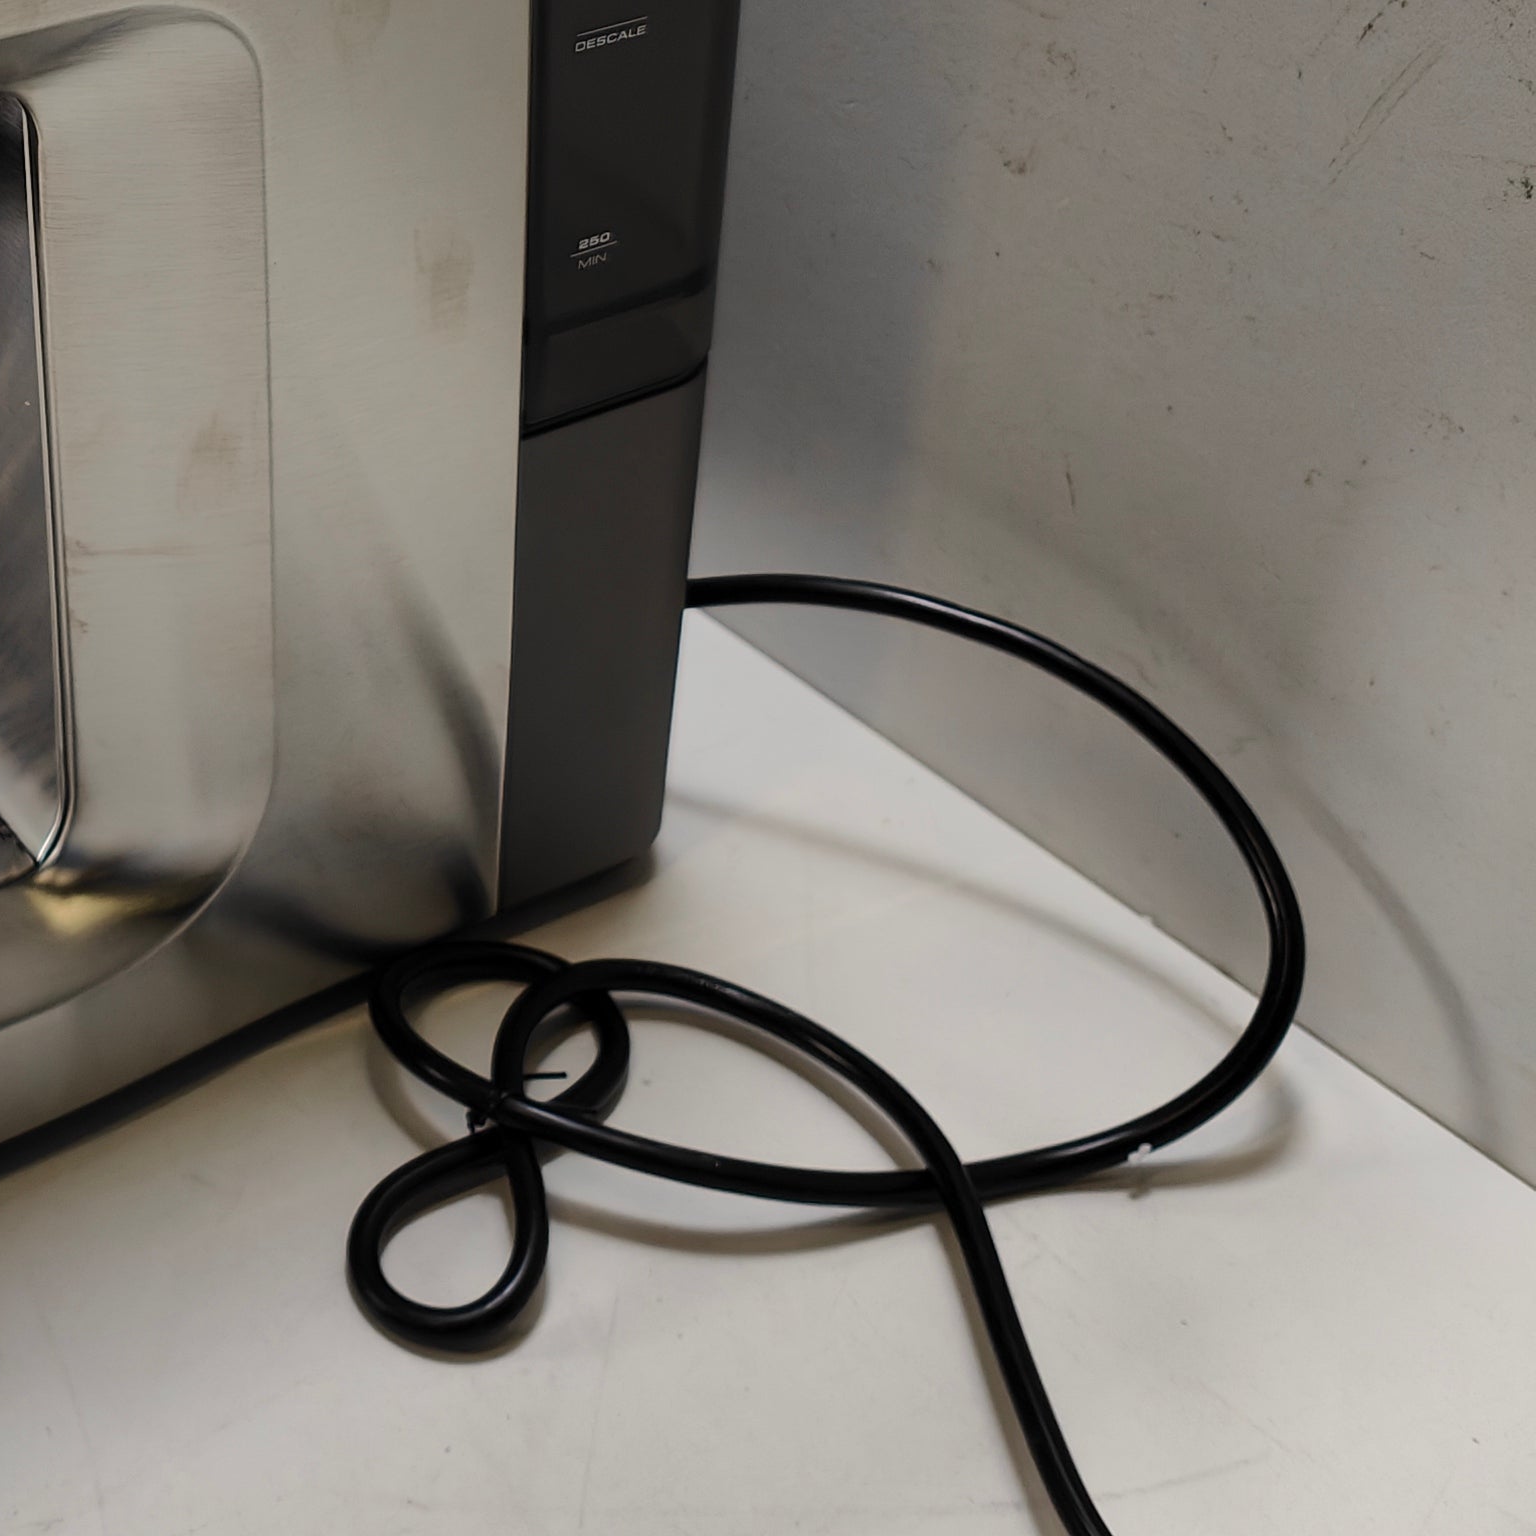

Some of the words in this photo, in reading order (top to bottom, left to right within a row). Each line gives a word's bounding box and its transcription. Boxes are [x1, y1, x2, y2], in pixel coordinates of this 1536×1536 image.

[575, 25, 647, 52] DESCALE
[578, 232, 610, 250] 250
[578, 252, 607, 269] MIN
